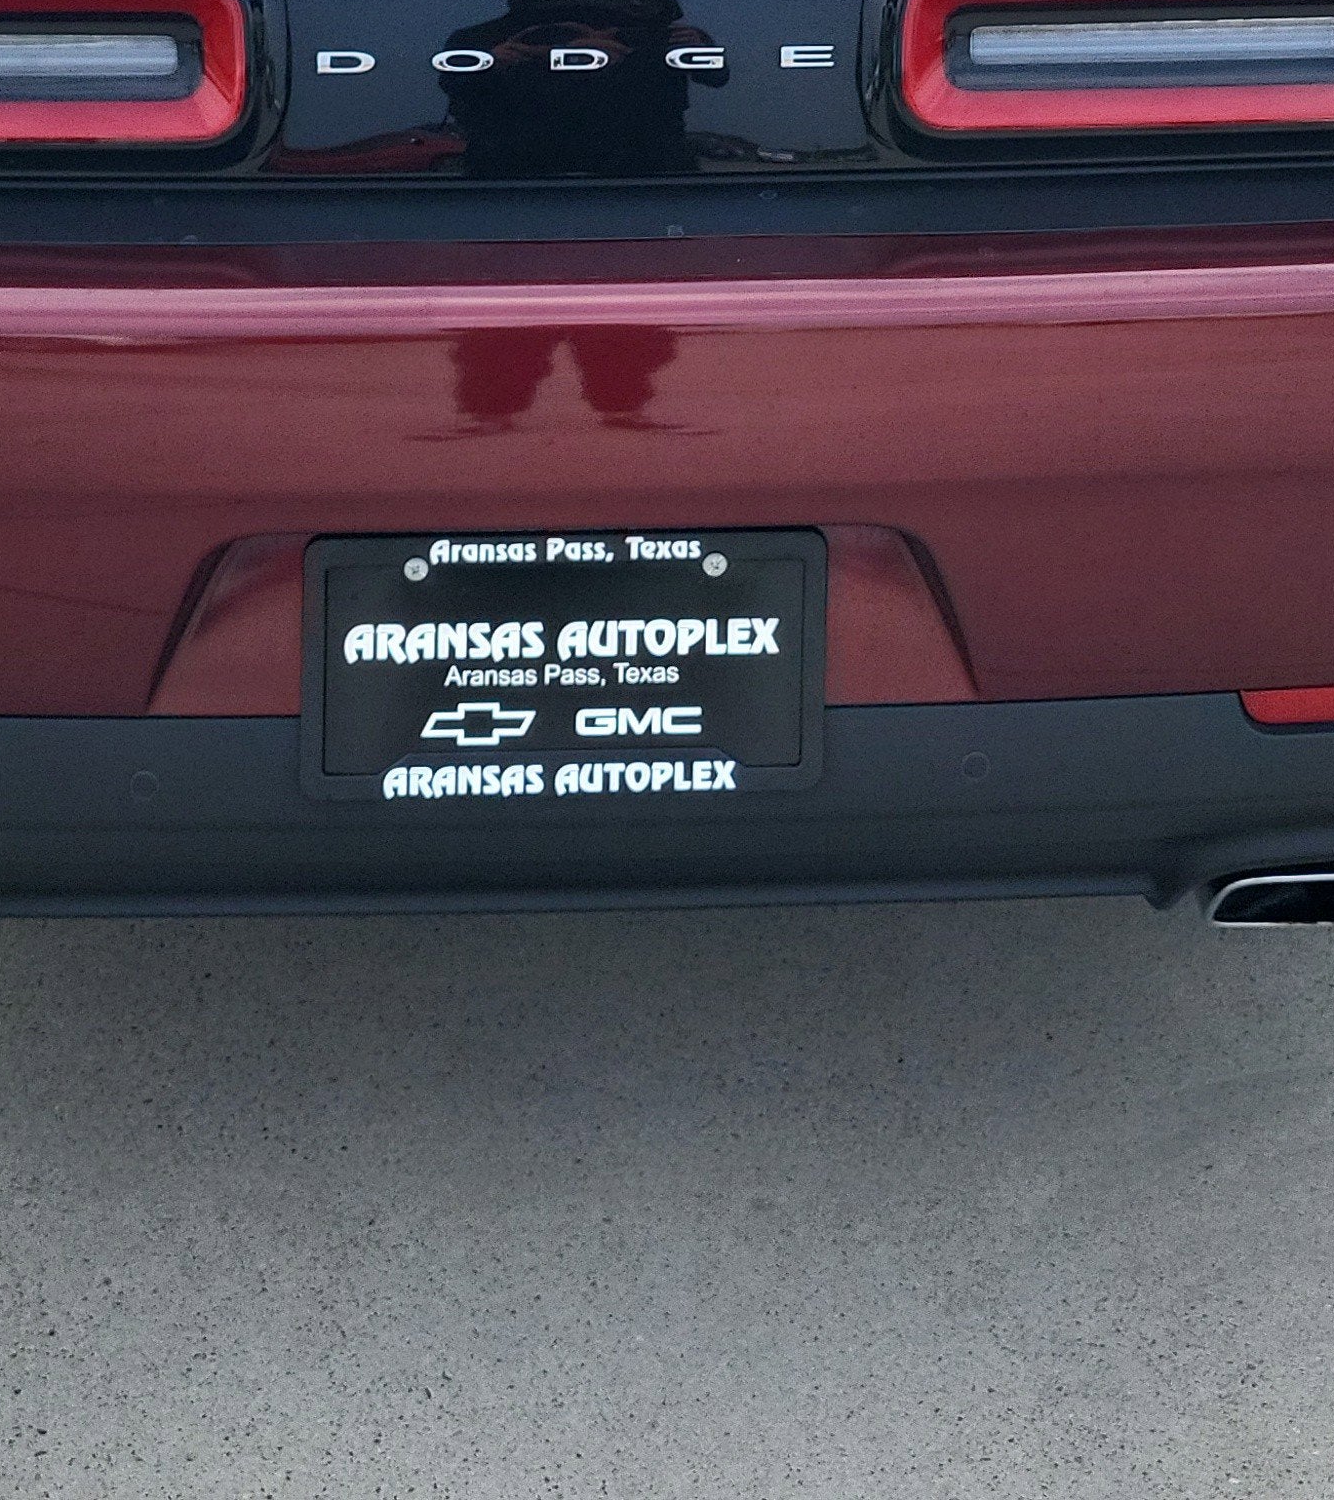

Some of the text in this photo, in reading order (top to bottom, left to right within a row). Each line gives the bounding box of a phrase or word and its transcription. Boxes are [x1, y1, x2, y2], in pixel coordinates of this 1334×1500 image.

[315, 44, 836, 75] DODGE
[429, 535, 702, 565] Aransas Pass, Texas
[343, 617, 779, 664] ARANSAS AUTOPLEX
[443, 662, 679, 688] Aransas Pass, Texas
[575, 706, 702, 736] GMC
[382, 760, 736, 800] ARANSAS AUTOPLEX
